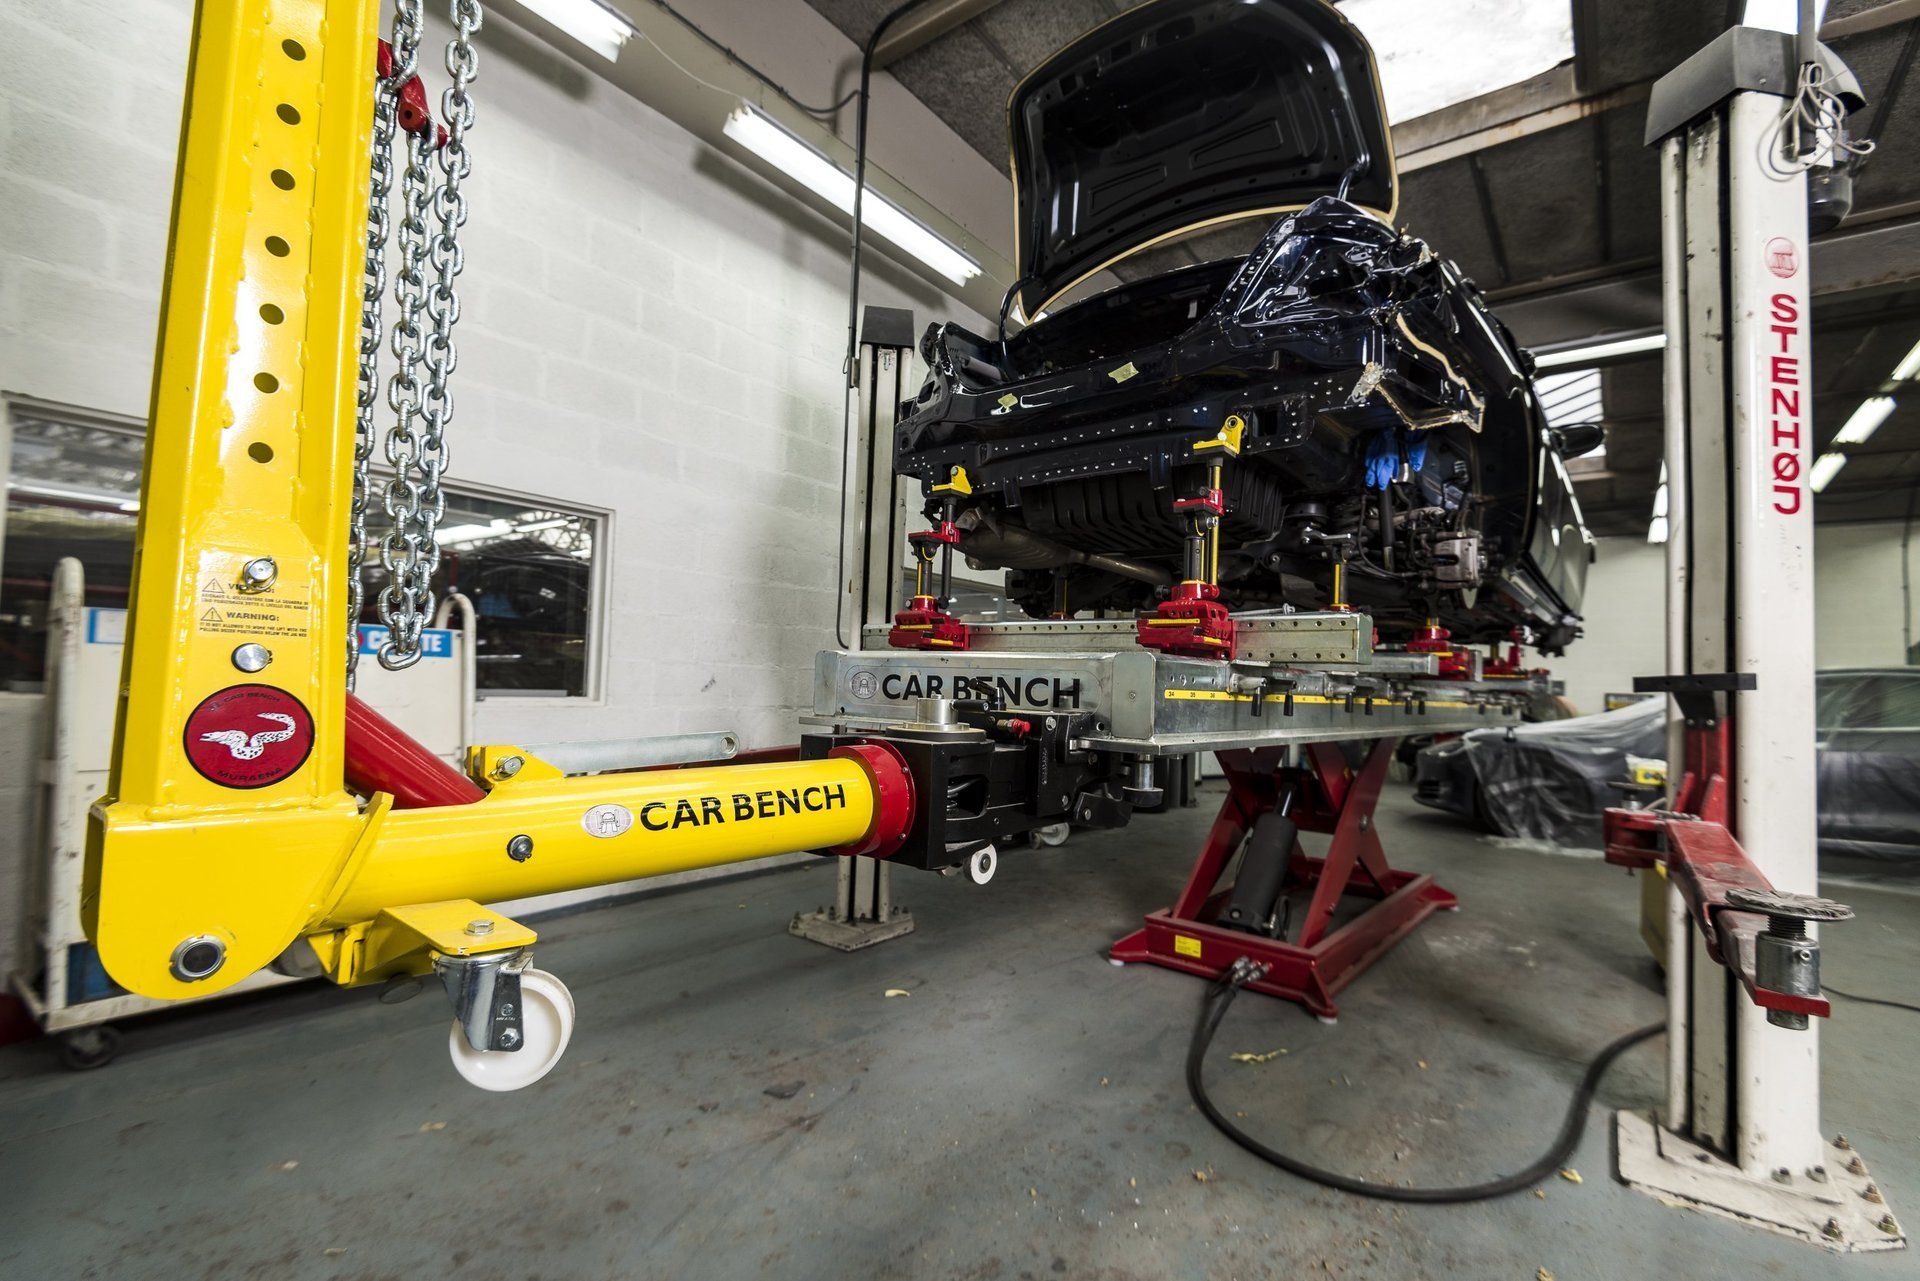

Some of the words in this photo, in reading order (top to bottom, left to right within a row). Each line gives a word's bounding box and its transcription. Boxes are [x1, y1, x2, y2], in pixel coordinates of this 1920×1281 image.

[226, 611, 280, 622] WARNING:
[881, 673, 944, 701] CAR
[639, 796, 726, 831] CAR
[732, 783, 847, 822] BENCH
